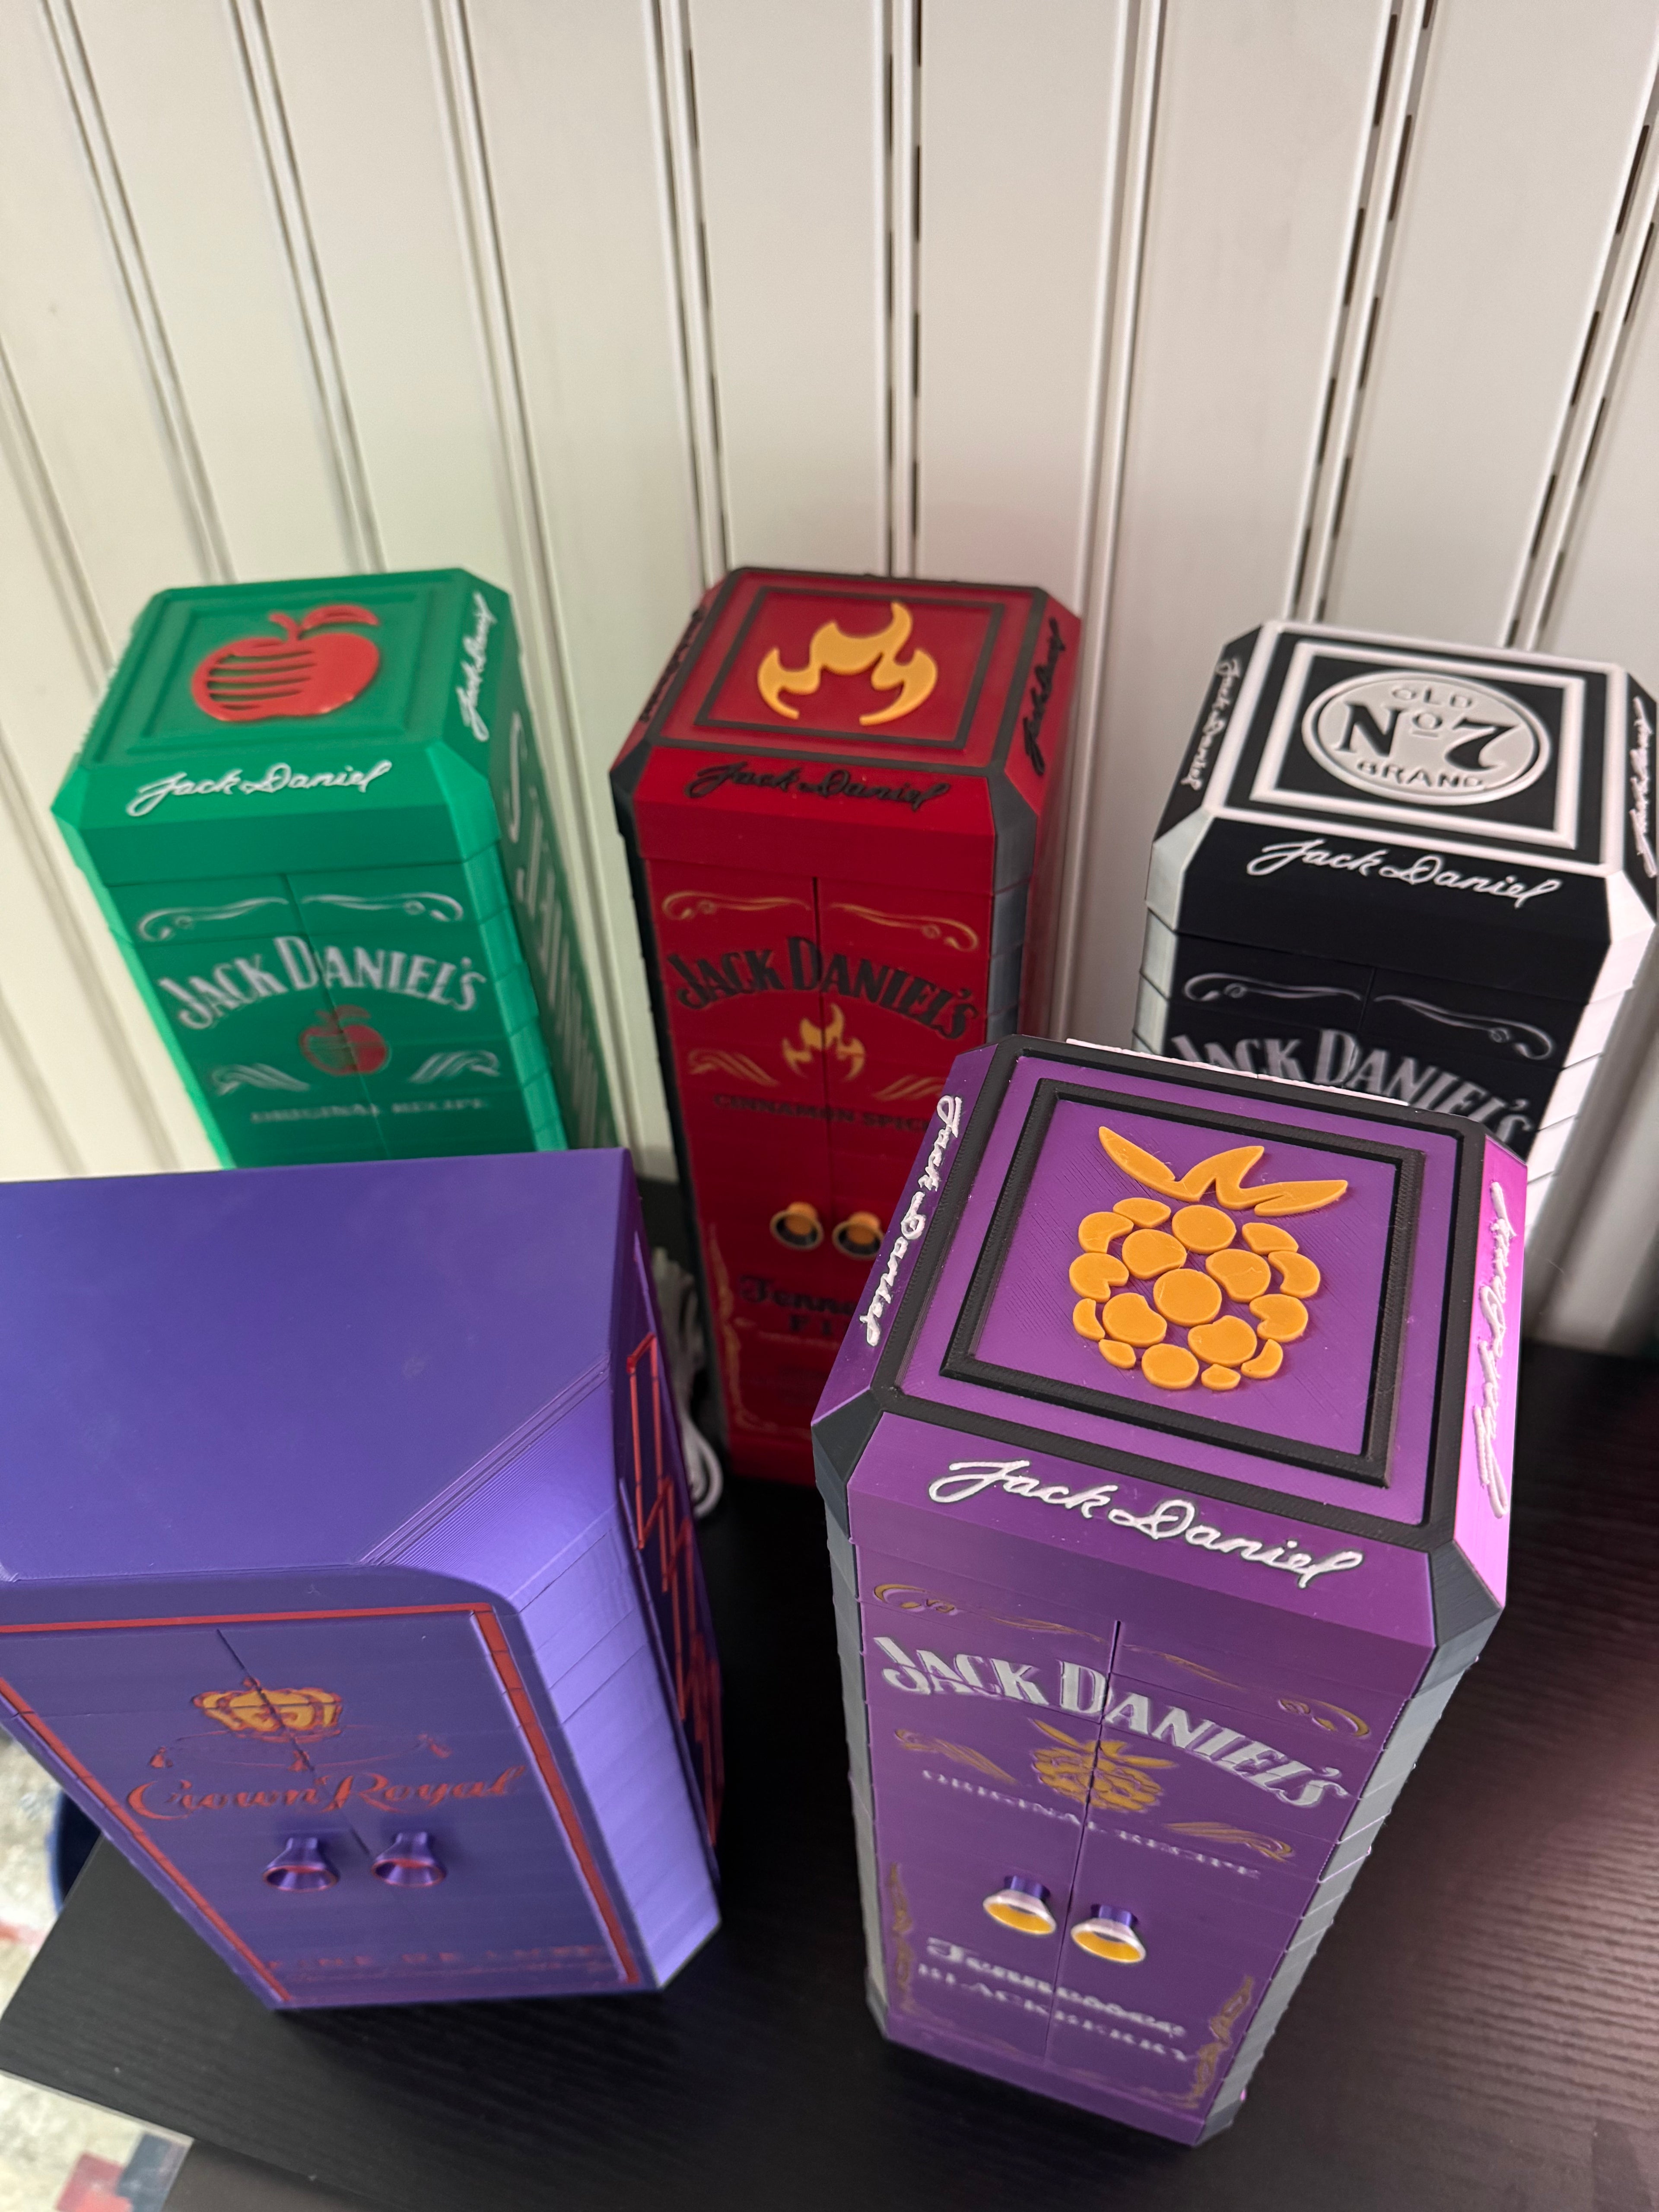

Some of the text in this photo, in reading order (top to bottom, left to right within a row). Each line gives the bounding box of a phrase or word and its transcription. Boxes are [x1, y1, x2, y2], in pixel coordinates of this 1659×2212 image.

[1391, 685, 1474, 709] OLD
[1357, 760, 1484, 788] BRAND
[1445, 716, 1520, 772] 7
[127, 760, 392, 817] Jack Daniel
[687, 762, 951, 813] Jack Daniel
[1247, 838, 1563, 909] Jack Daniel
[158, 934, 487, 1030] JACK DANIEL'S
[667, 936, 980, 1040] JACK DANIEL'S
[859, 1094, 963, 1347] Jack Daniel
[929, 1460, 1364, 1589] Jack Daniel
[873, 1637, 1349, 1808] JACK DANIEL'S
[127, 1764, 526, 1821] Crown Royal
